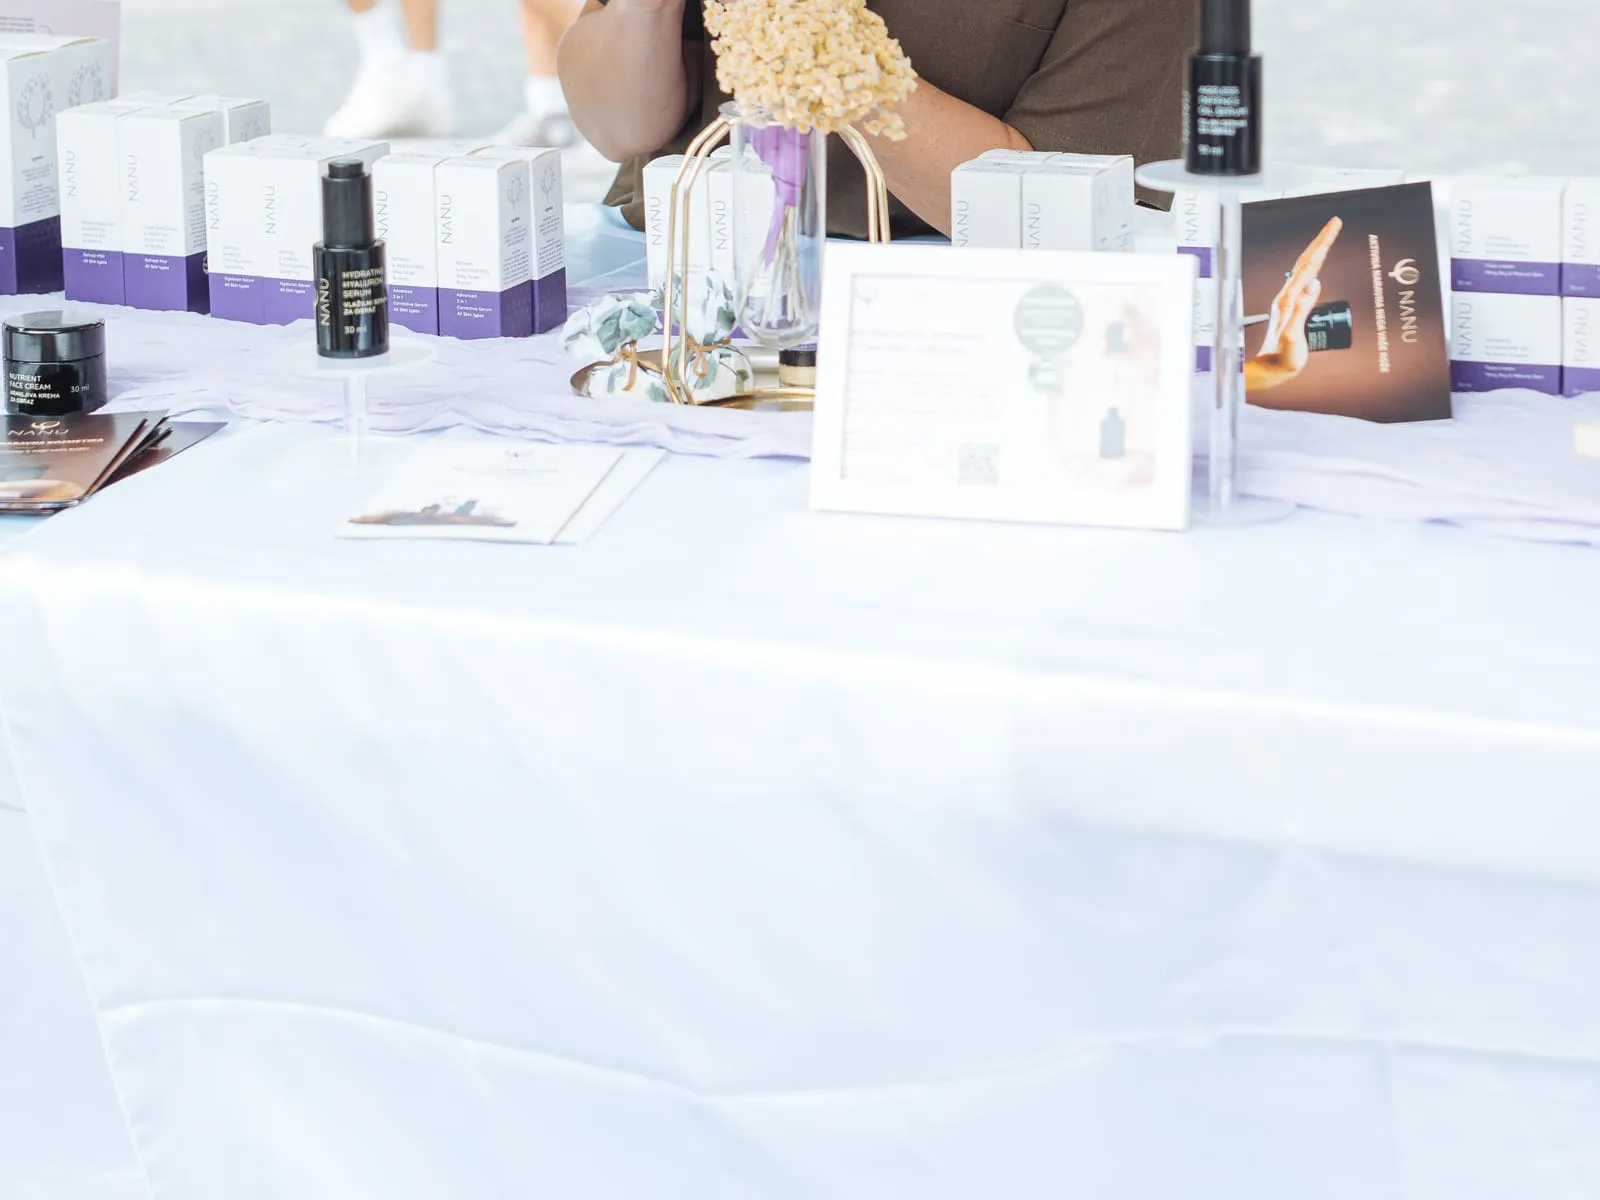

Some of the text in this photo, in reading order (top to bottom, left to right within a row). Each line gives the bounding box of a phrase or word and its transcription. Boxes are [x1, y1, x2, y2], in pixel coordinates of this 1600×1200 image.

[65, 150, 77, 197] NANU
[128, 154, 139, 201] NANU
[208, 181, 221, 230] NANU
[264, 185, 277, 234] NANU
[440, 195, 453, 244] NANU
[649, 196, 662, 246] NANU
[715, 200, 728, 250] NANU
[1458, 199, 1473, 254] NANU
[319, 278, 331, 327] NANU
[343, 288, 372, 299] SERUM
[1398, 290, 1418, 344] NANU
[1457, 302, 1473, 356] NANU
[9, 372, 42, 382] NUTRIENT
[9, 380, 52, 391] FACE CREAM
[81, 384, 90, 392] ml
